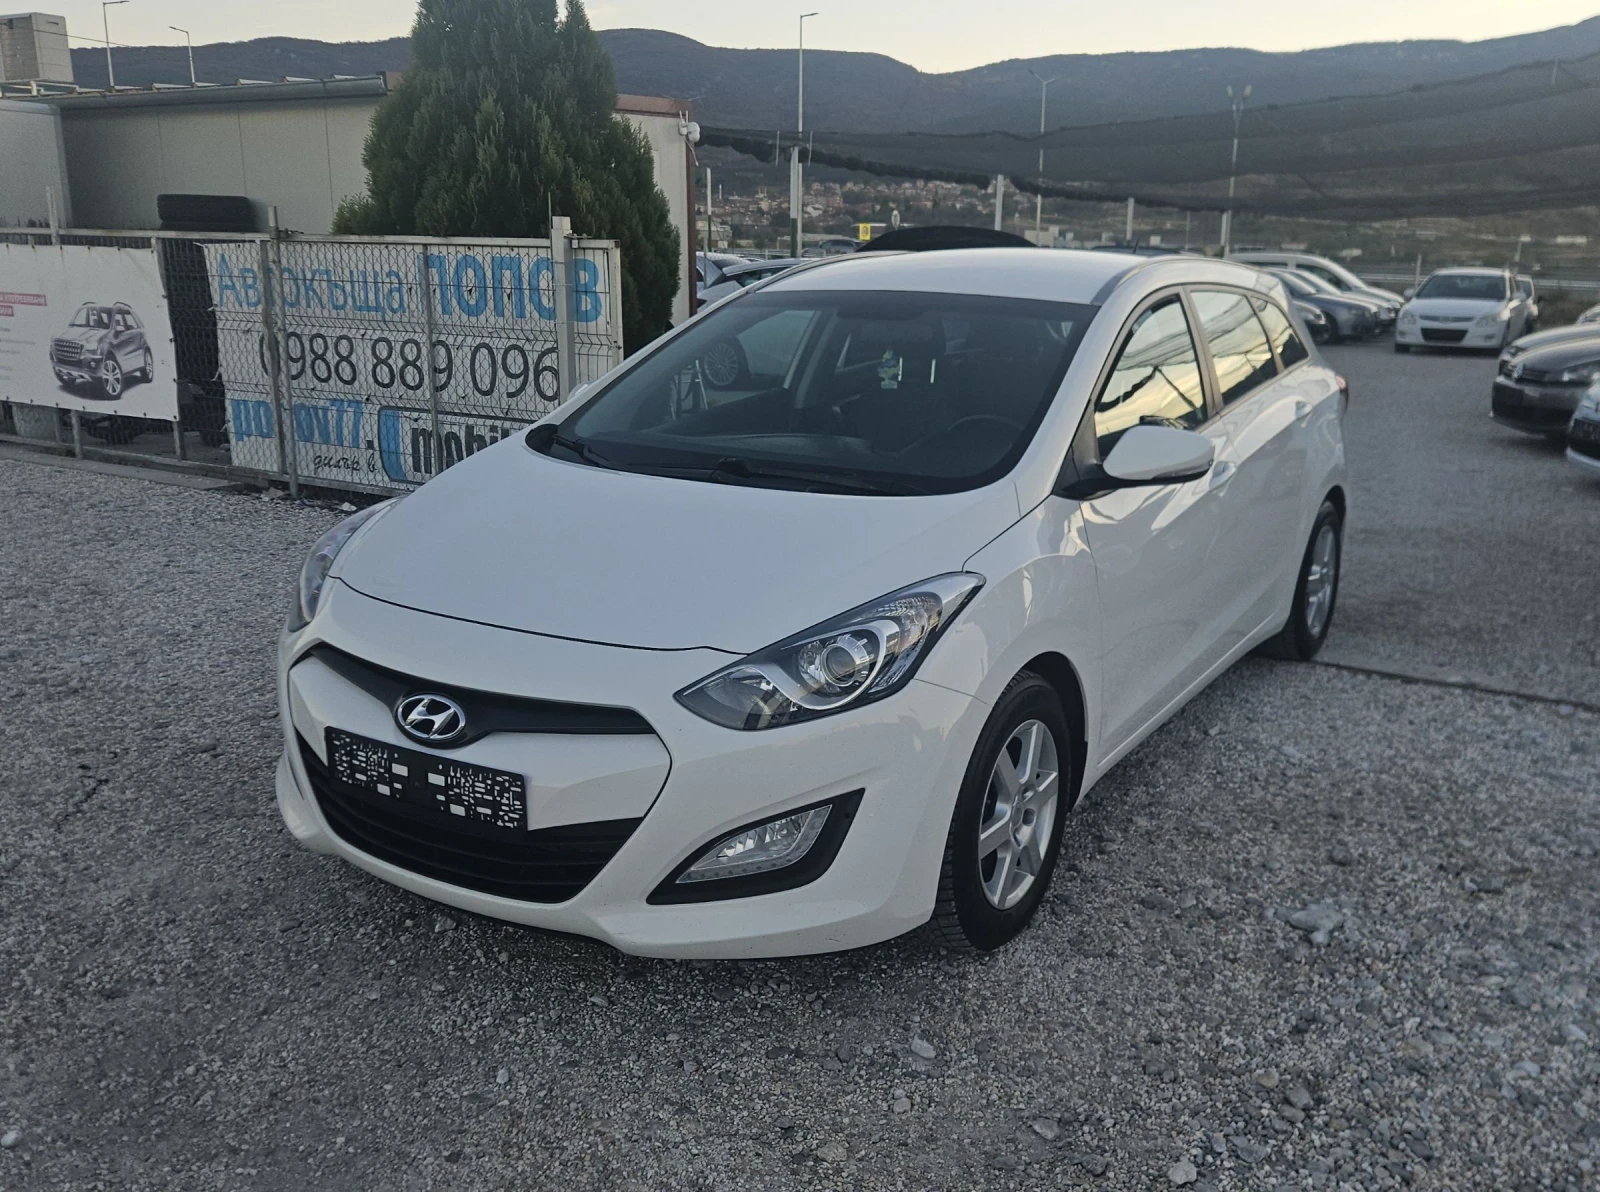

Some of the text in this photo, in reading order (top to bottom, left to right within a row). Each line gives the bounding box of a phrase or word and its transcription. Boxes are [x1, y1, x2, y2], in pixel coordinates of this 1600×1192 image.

[259, 331, 560, 402] 0988 889 096
[231, 399, 375, 450] poov77.
